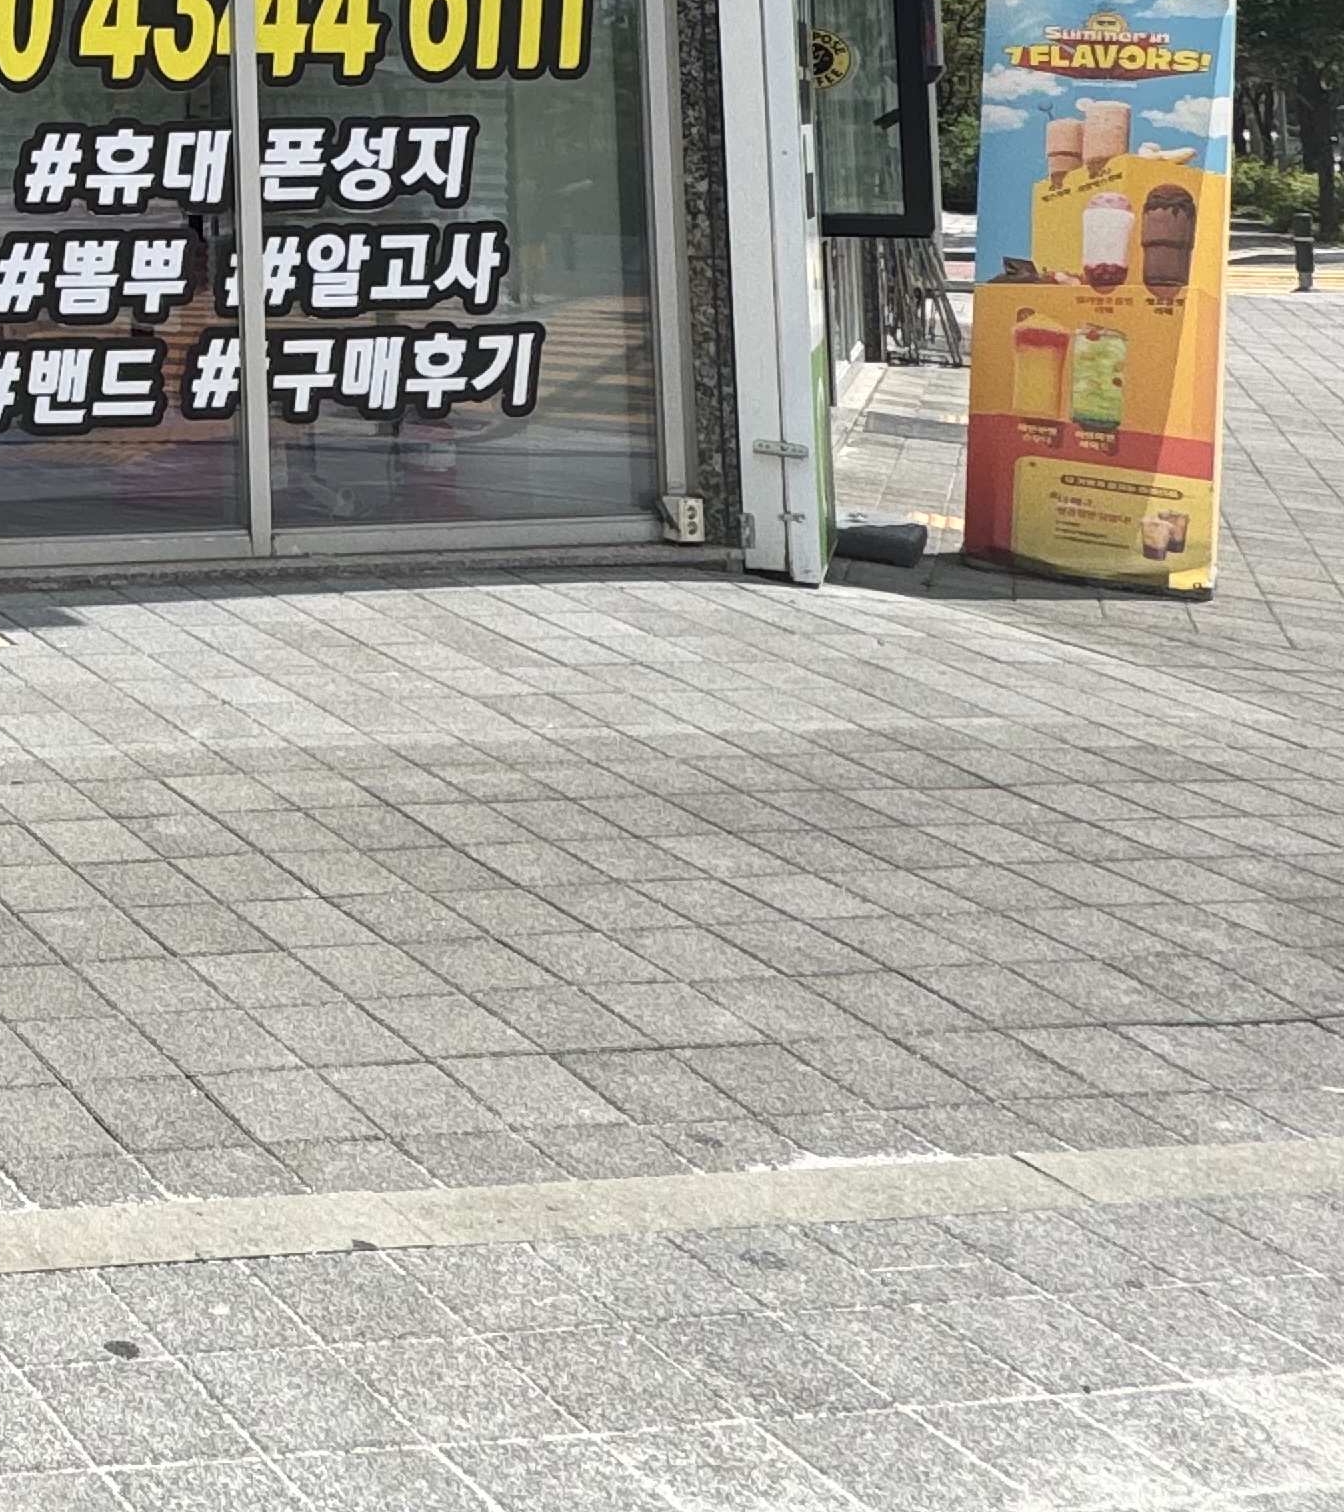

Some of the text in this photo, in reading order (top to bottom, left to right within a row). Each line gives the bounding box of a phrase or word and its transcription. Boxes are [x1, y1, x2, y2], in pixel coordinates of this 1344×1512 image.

[1029, 44, 1211, 72] FLAVORS!
[1045, 26, 1170, 44] Summer in
[24, 124, 470, 206] #휴대폰성지
[191, 332, 536, 411] #구매후기
